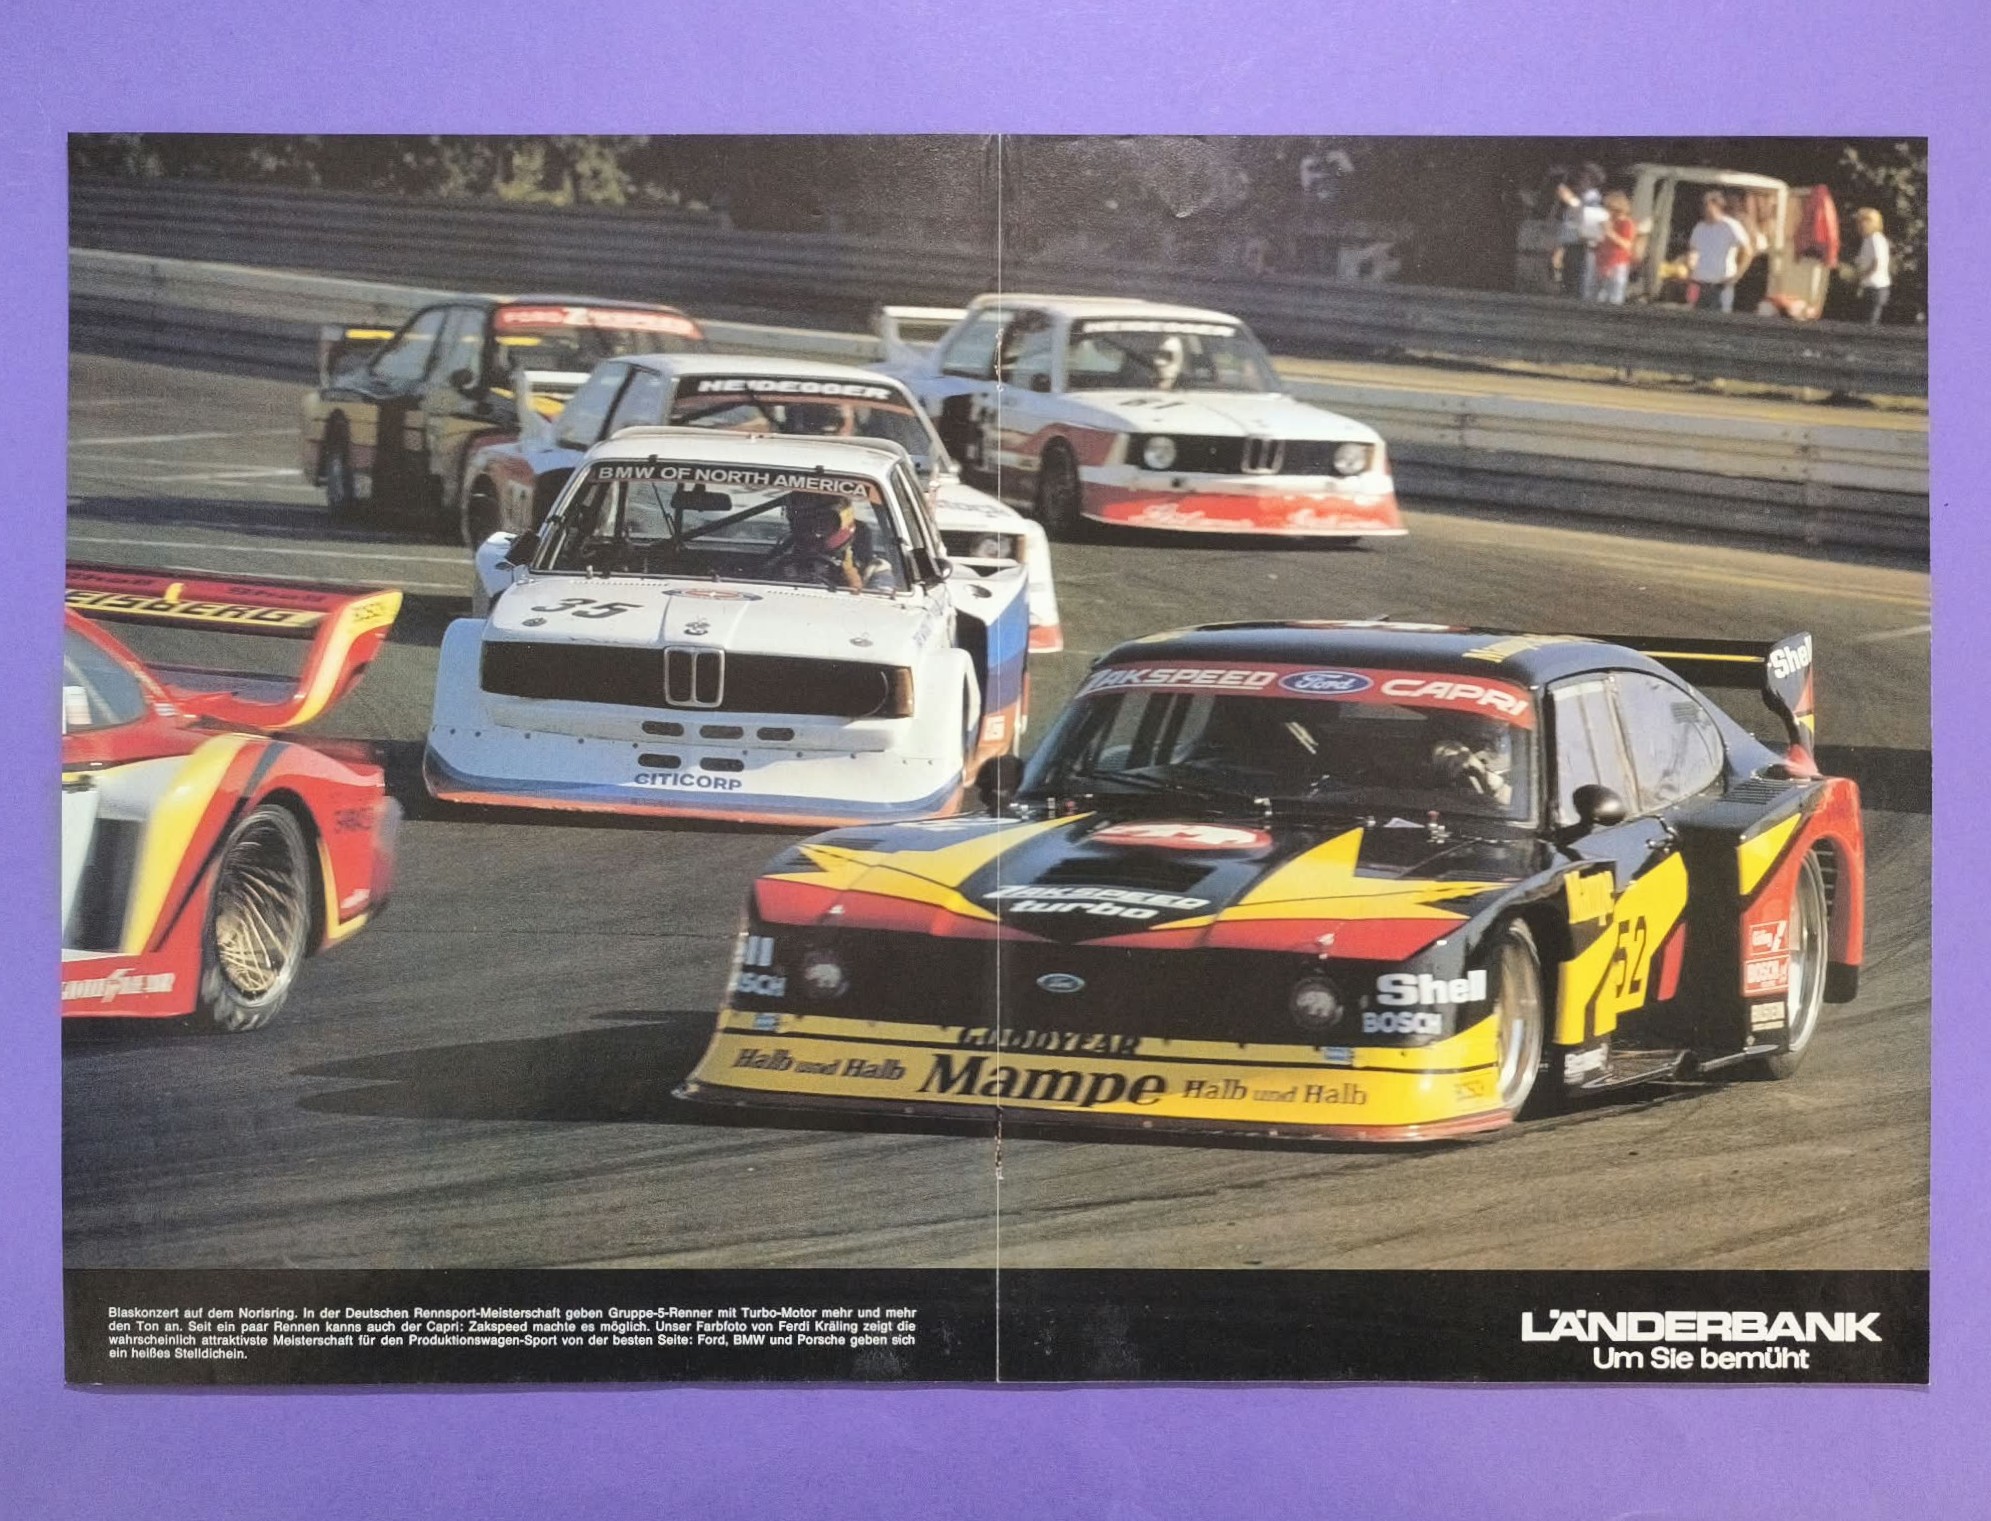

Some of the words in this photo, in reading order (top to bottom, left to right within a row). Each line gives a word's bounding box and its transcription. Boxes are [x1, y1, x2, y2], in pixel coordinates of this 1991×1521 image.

[598, 466, 655, 480] BMW
[659, 466, 691, 481] OF
[694, 468, 770, 486] NORTH
[773, 474, 868, 497] AMERICA
[531, 597, 644, 619] 35
[1769, 635, 1813, 678] Shell
[1291, 672, 1357, 692] Ford
[1380, 678, 1529, 716] CAPRI
[633, 772, 743, 791] CITICORP
[1009, 899, 1160, 919] turbo
[1613, 914, 1648, 999] 52
[1375, 969, 1488, 1006] Shell
[917, 1053, 1167, 1108] Mampe
[1181, 1077, 1248, 1101] Halb
[1302, 1082, 1368, 1106] Halb
[108, 1307, 179, 1318] Blaskonzert
[184, 1307, 203, 1318] auf
[208, 1308, 233, 1318] dem
[239, 1307, 298, 1321] Norisring.
[303, 1307, 314, 1318] In
[320, 1307, 341, 1318] der
[345, 1307, 410, 1318] Deutschen
[414, 1307, 561, 1321] Rennsport-Meisterschaft
[565, 1307, 603, 1321] geben
[608, 1307, 713, 1320] Gruppe-5-Renner
[718, 1307, 737, 1318] mit
[741, 1307, 817, 1318] Turbo-Motor
[822, 1307, 853, 1318] mehr
[858, 1307, 880, 1318] und
[886, 1307, 917, 1318] mehr
[1521, 1309, 1883, 1342] LÄNDERBANK
[108, 1321, 130, 1331] den
[136, 1321, 159, 1331] Ton
[164, 1323, 183, 1331] an.
[188, 1321, 212, 1331] Seit
[217, 1321, 235, 1331] ein
[241, 1323, 269, 1334] paar
[274, 1321, 320, 1331] Rennen
[326, 1321, 361, 1331] kanns
[367, 1321, 395, 1331] auch
[401, 1321, 422, 1331] der
[426, 1321, 463, 1334] Capri:
[468, 1321, 527, 1334] Zakspeed
[533, 1321, 576, 1331] machte
[581, 1323, 595, 1331] es
[600, 1321, 650, 1334] möglich.
[656, 1321, 692, 1331] Unser
[696, 1321, 747, 1331] Farbfoto
[751, 1323, 773, 1331] von
[779, 1321, 809, 1331] Ferdi
[815, 1321, 858, 1334] Kräling
[863, 1321, 893, 1334] zeigt
[897, 1321, 916, 1331] die
[108, 1347, 127, 1358] ein
[131, 1347, 171, 1358] heißes
[174, 1347, 248, 1358] Stelldichein.
[109, 1334, 196, 1345] wahrscheinlich
[201, 1334, 268, 1345] attraktivste
[273, 1334, 353, 1345] Meisterschaft
[358, 1335, 376, 1345] für
[381, 1335, 403, 1345] den
[409, 1334, 557, 1348] Produktionswagen-Sport
[562, 1337, 583, 1345] von
[588, 1334, 608, 1345] der
[613, 1334, 653, 1345] besten
[658, 1334, 692, 1345] Seite:
[698, 1334, 728, 1346] Ford,
[733, 1334, 765, 1345] BMW
[770, 1334, 792, 1345] und
[798, 1334, 845, 1345] Porsche
[850, 1334, 887, 1348] geben
[892, 1334, 915, 1345] sich
[1592, 1346, 1644, 1369] Um
[1650, 1345, 1694, 1369] Sie
[1700, 1345, 1810, 1370] bemüht
